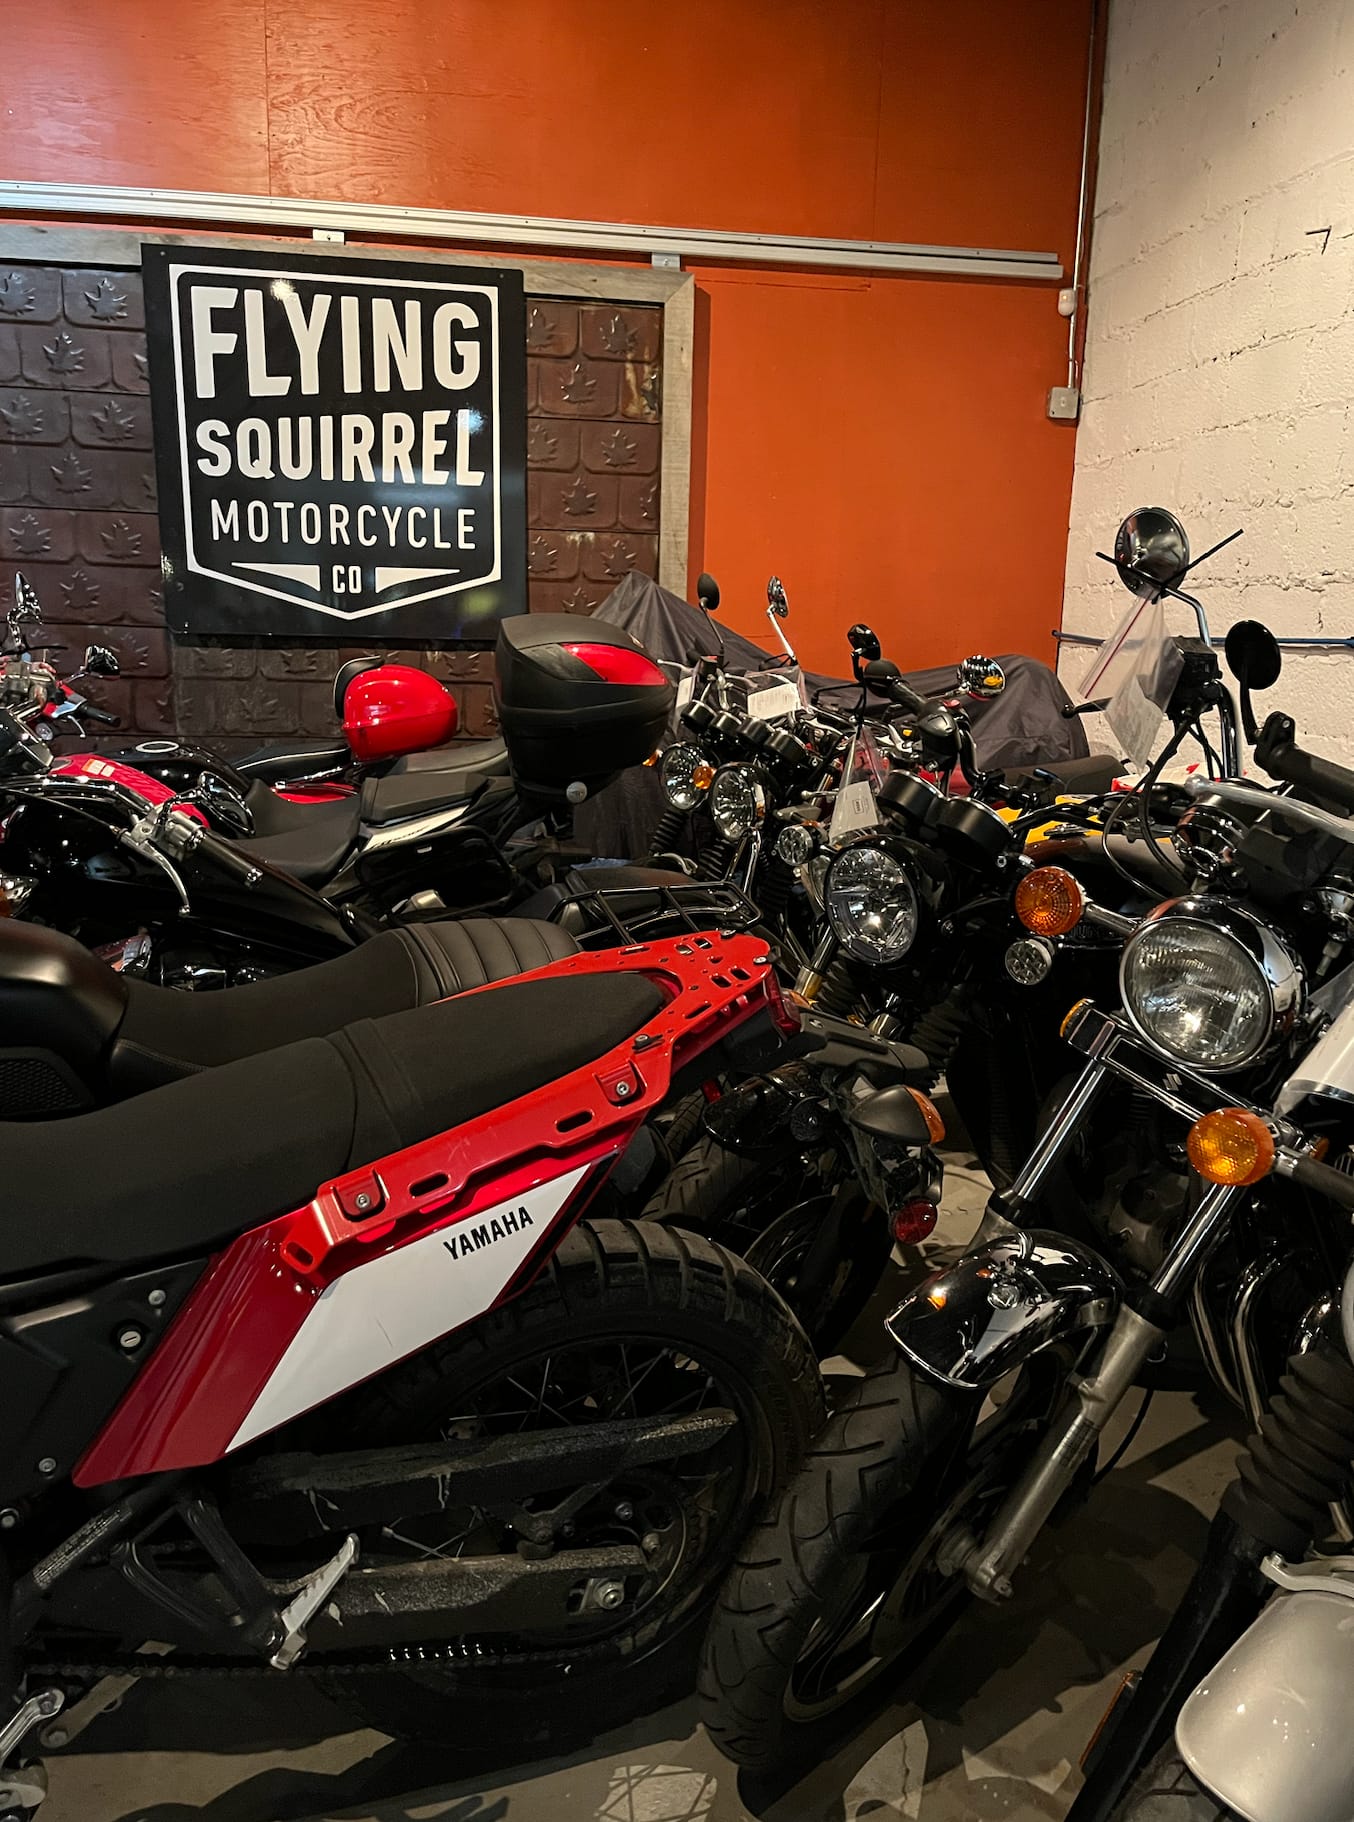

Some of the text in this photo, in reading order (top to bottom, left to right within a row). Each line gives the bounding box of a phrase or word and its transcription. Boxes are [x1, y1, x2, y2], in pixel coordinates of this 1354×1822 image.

[190, 285, 481, 399] FLYING
[195, 409, 485, 487] SQUIRREL
[210, 498, 476, 550] MOTORCYCLE
[332, 564, 362, 594] CO
[443, 1206, 535, 1261] YAMAHA
